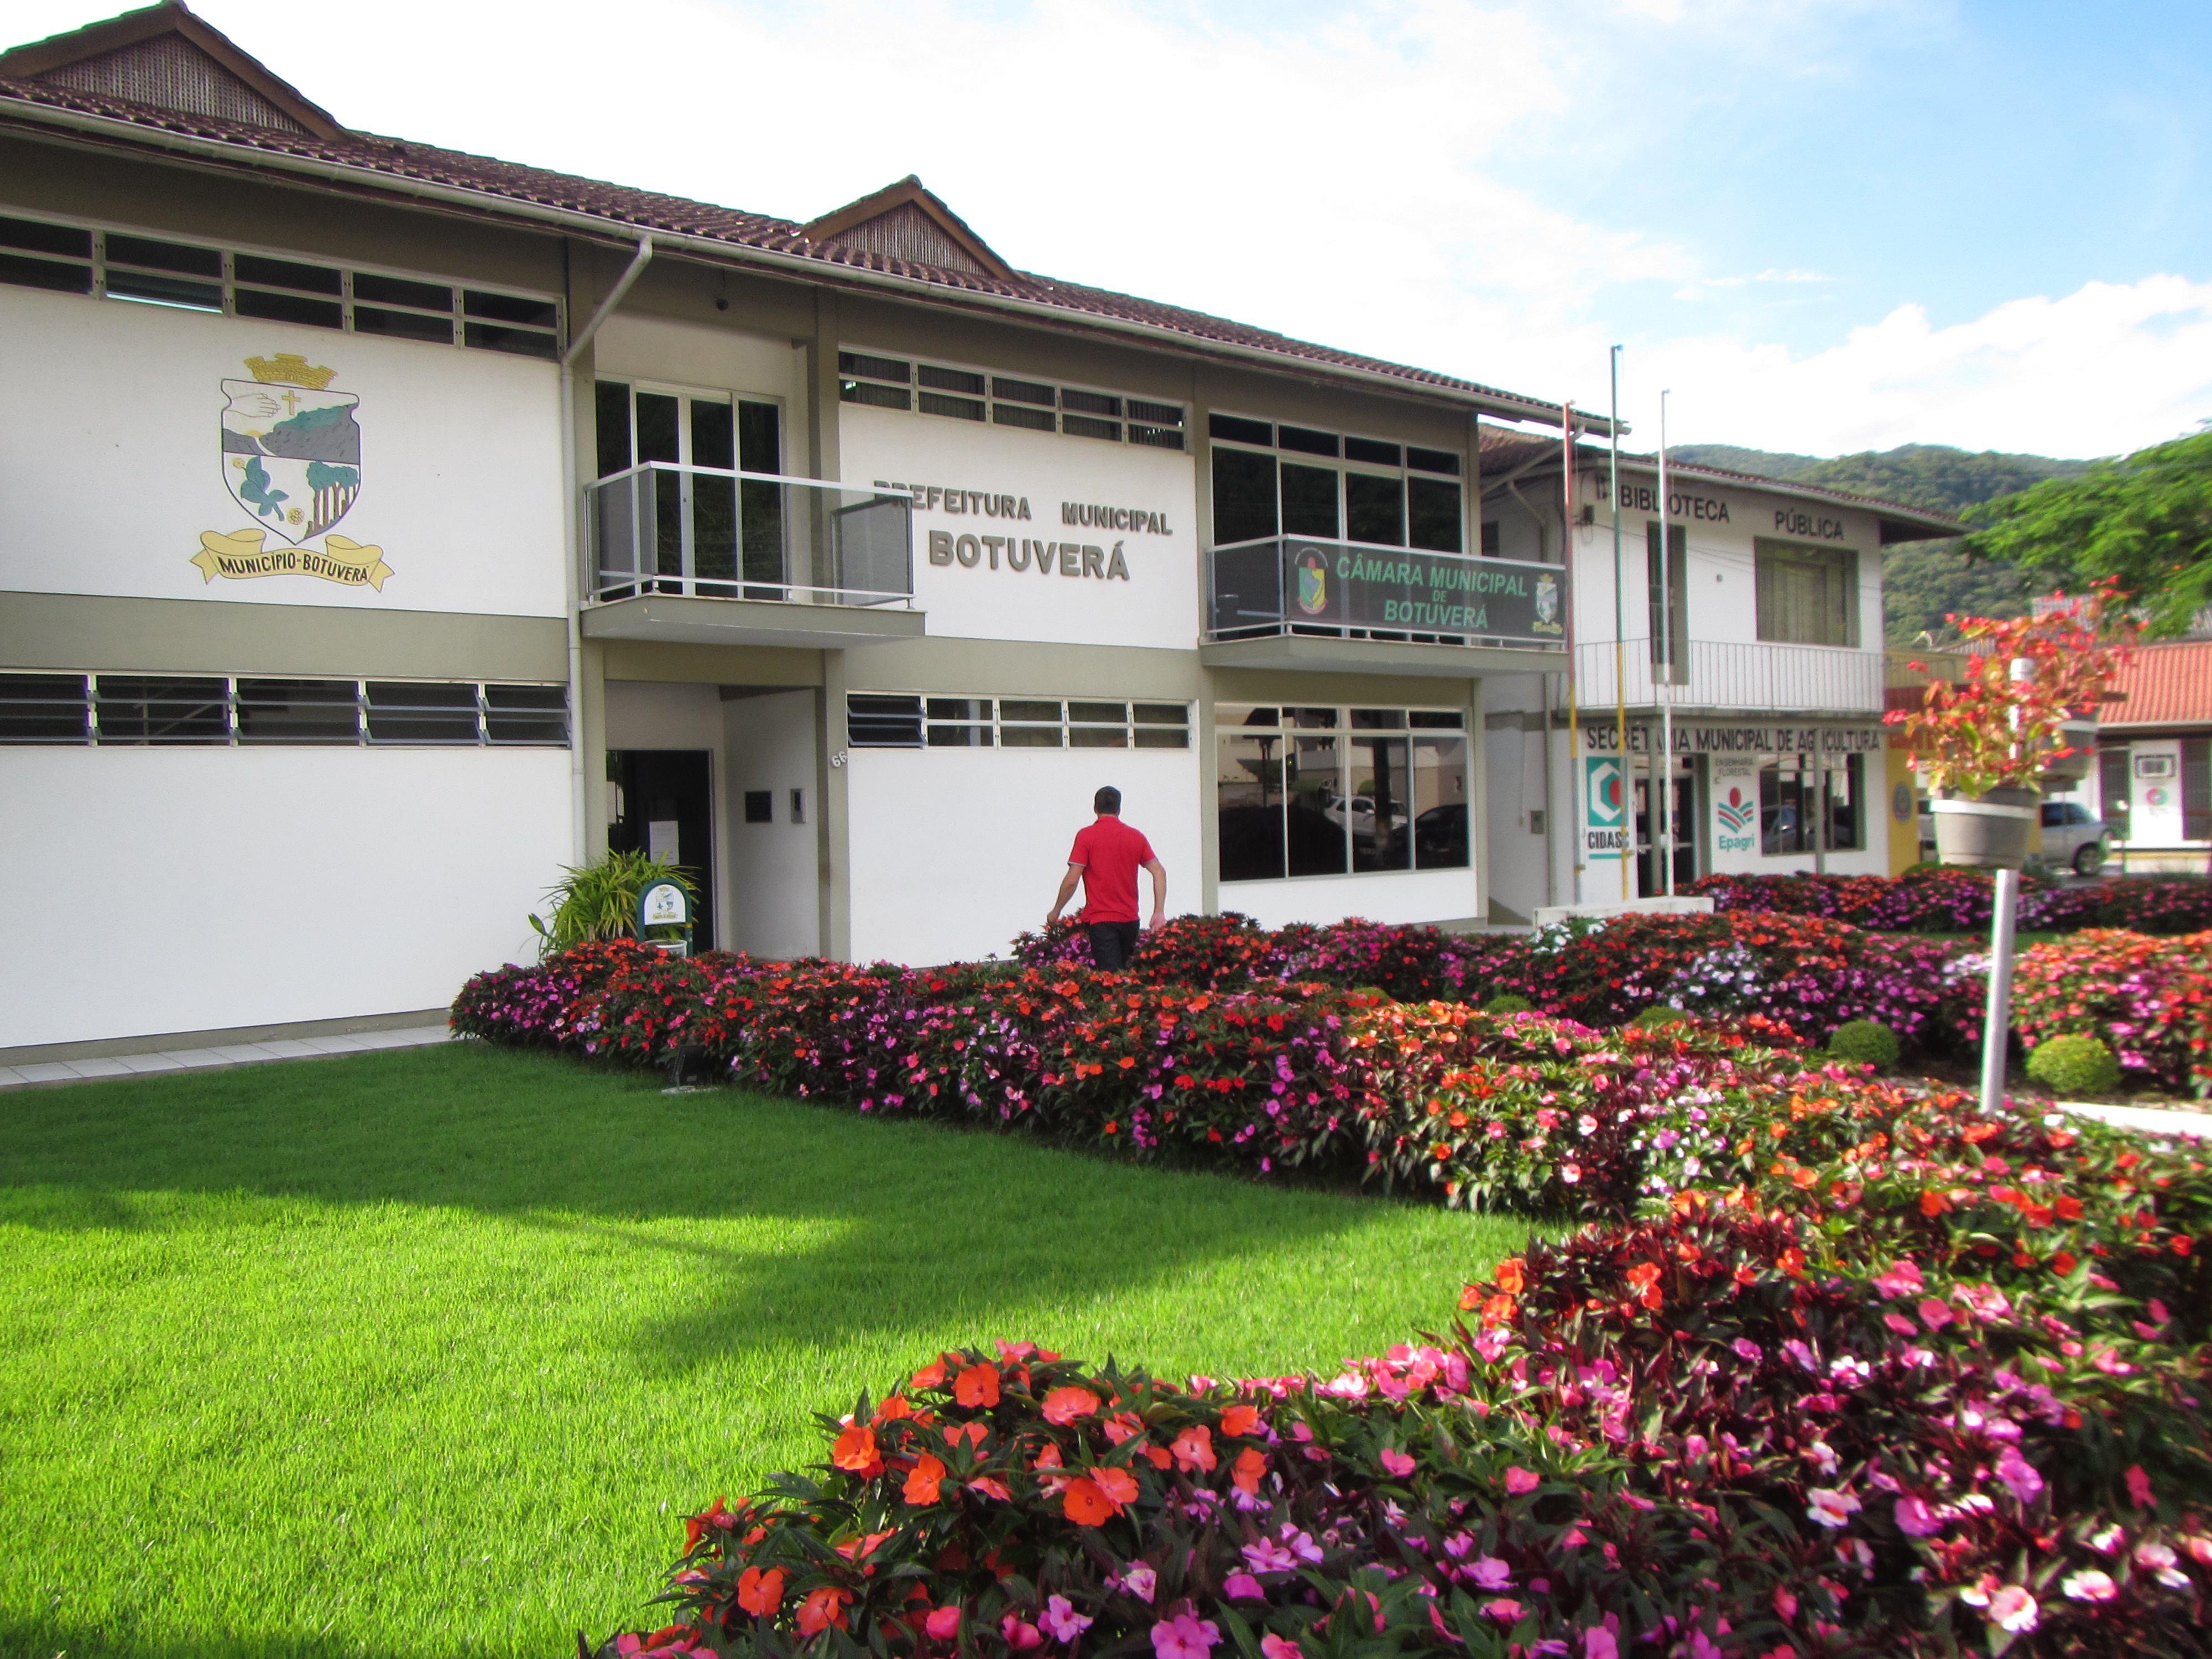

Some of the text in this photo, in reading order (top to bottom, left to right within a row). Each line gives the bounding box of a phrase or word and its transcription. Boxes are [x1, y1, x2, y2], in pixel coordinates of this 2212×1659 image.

[1062, 502, 1173, 535] MUNICIPAL
[1621, 484, 1844, 540] BIBLOTECA PÚBLICA
[929, 529, 1130, 581] BOTUVERÁ
[1335, 554, 1424, 586] CÂMARA
[1429, 566, 1528, 597] MUNICIPAL
[1432, 589, 1447, 603] DE
[1384, 599, 1488, 629] BOTUVERÁ
[1695, 728, 1773, 752] MUNICIPAL
[1777, 729, 1793, 752] DE
[1797, 729, 1881, 752] AGICULTURA
[831, 750, 848, 768] 66
[1718, 834, 1755, 852] Epagri
